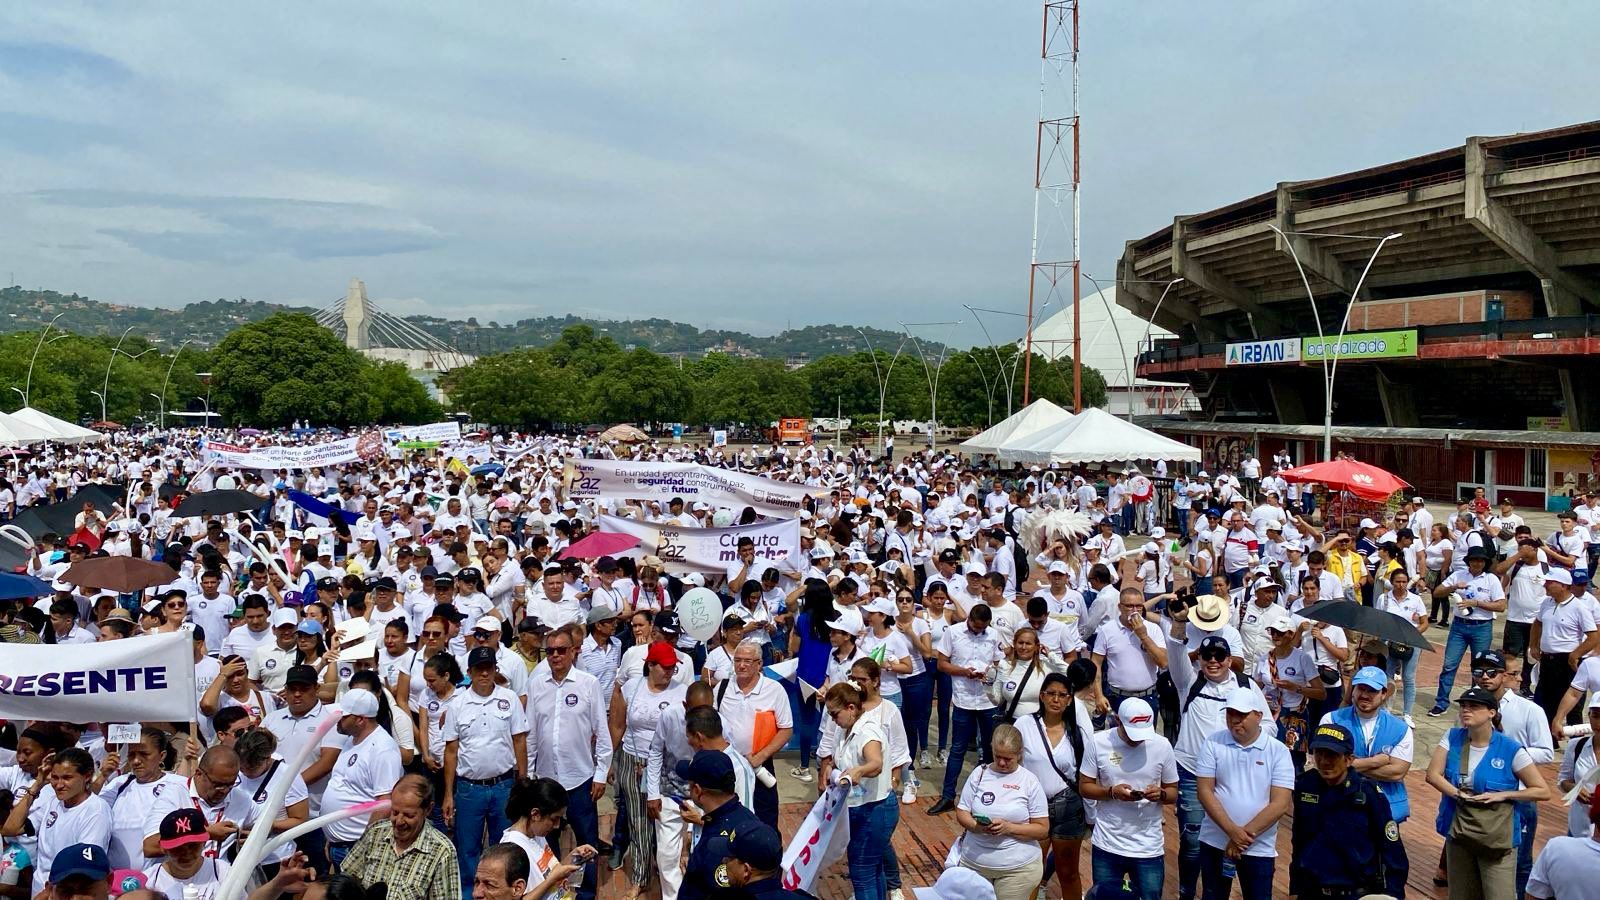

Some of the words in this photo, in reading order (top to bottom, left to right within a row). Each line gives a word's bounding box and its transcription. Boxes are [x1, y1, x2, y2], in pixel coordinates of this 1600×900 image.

[302, 449, 353, 462] oportunidades
[313, 443, 350, 454] Santander
[574, 464, 594, 472] Mano
[570, 471, 601, 490] Paz
[615, 469, 627, 477] En
[629, 469, 660, 477] unidad
[662, 471, 719, 484] encontramos
[729, 481, 746, 490] paz,
[637, 477, 684, 486] seguridad
[685, 479, 737, 494] construimos
[671, 486, 699, 494] futuro
[765, 495, 800, 509] Gobierno
[659, 530, 680, 538] Mano
[719, 532, 779, 547] Cúuta
[655, 537, 687, 558] Paz
